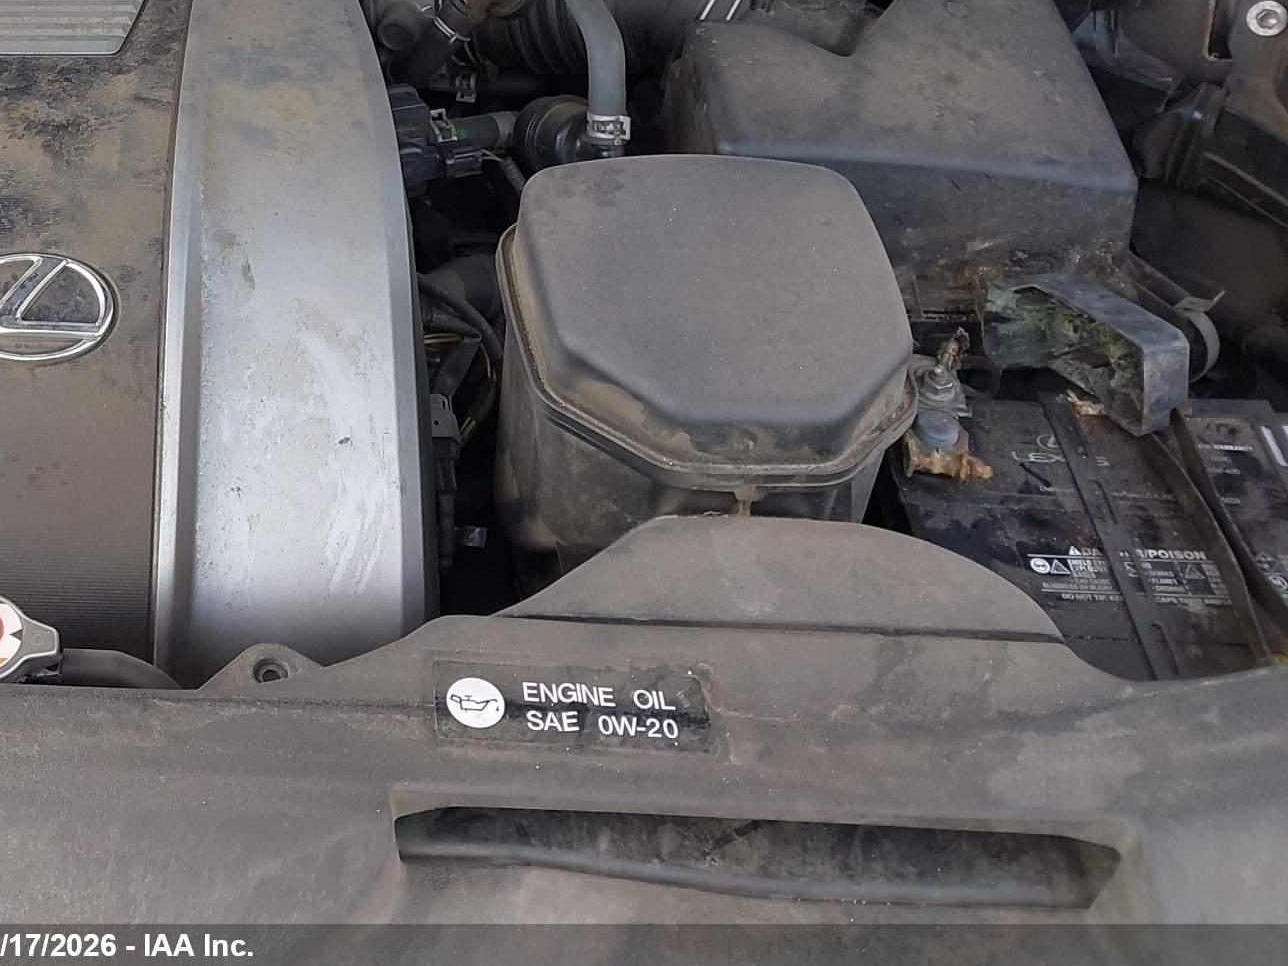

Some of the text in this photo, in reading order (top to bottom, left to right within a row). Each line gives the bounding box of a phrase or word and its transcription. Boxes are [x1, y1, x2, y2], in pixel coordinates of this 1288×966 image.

[522, 681, 676, 711] ENGINE OIL
[526, 710, 679, 739] SAE 0W-20
